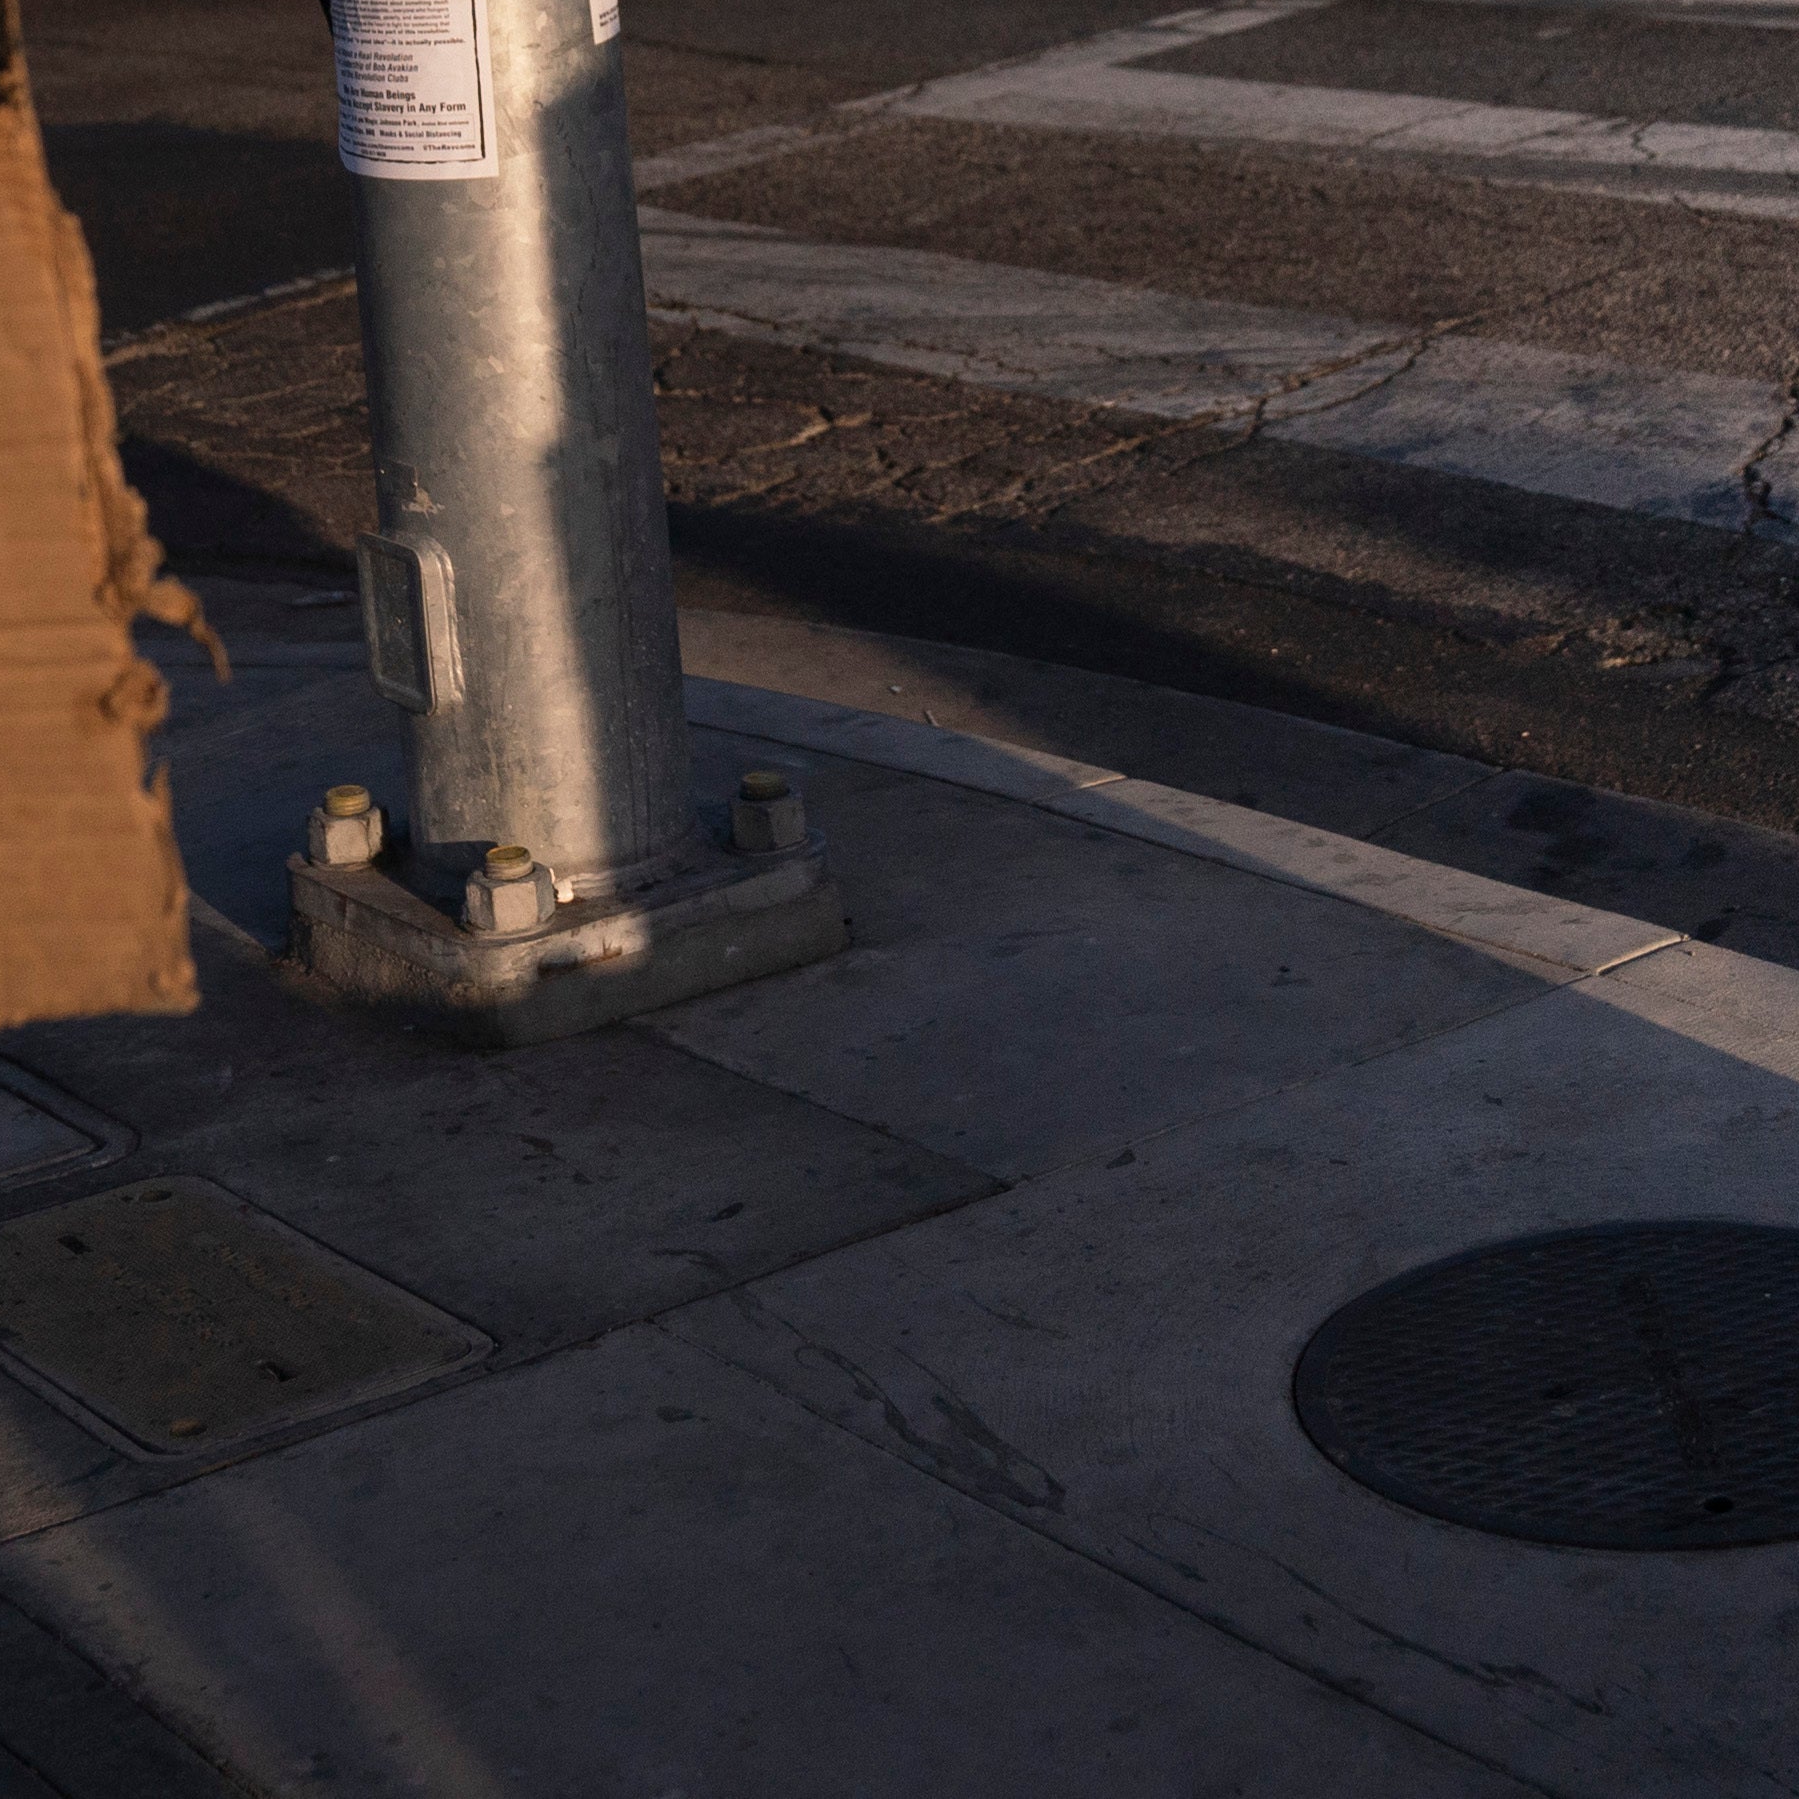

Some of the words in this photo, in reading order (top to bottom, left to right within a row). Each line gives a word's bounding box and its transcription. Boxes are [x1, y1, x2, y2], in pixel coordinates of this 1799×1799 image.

[373, 52, 413, 61] Revolution
[386, 89, 416, 101] Beings
[374, 101, 404, 114] Slavery
[407, 101, 416, 112] in
[419, 102, 436, 114] Any
[440, 102, 466, 112] Form
